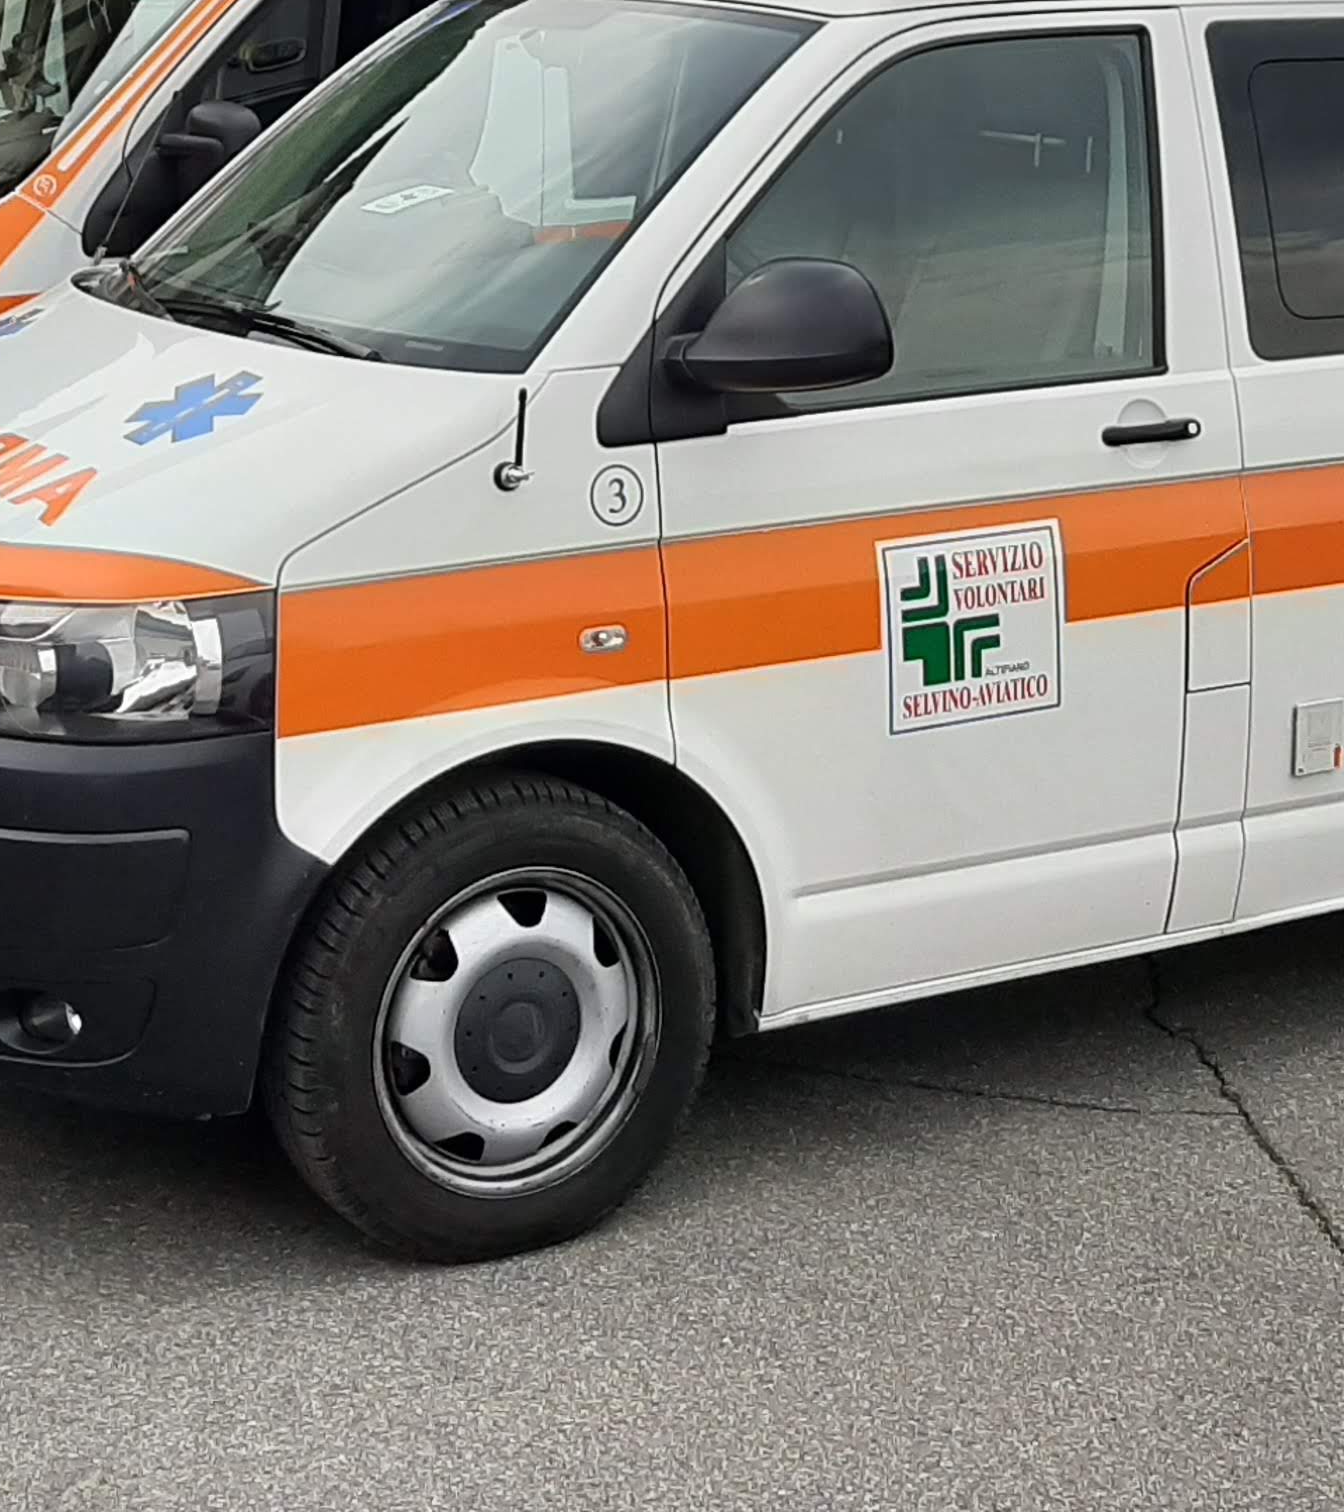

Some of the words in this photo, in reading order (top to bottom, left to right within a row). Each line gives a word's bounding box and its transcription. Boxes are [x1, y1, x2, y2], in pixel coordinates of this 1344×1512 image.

[608, 477, 627, 514] 3
[951, 541, 1044, 581] SERVIZIO
[952, 575, 1046, 612] VOLONTARI
[902, 673, 1049, 720] SELVINO-AVIATICO
